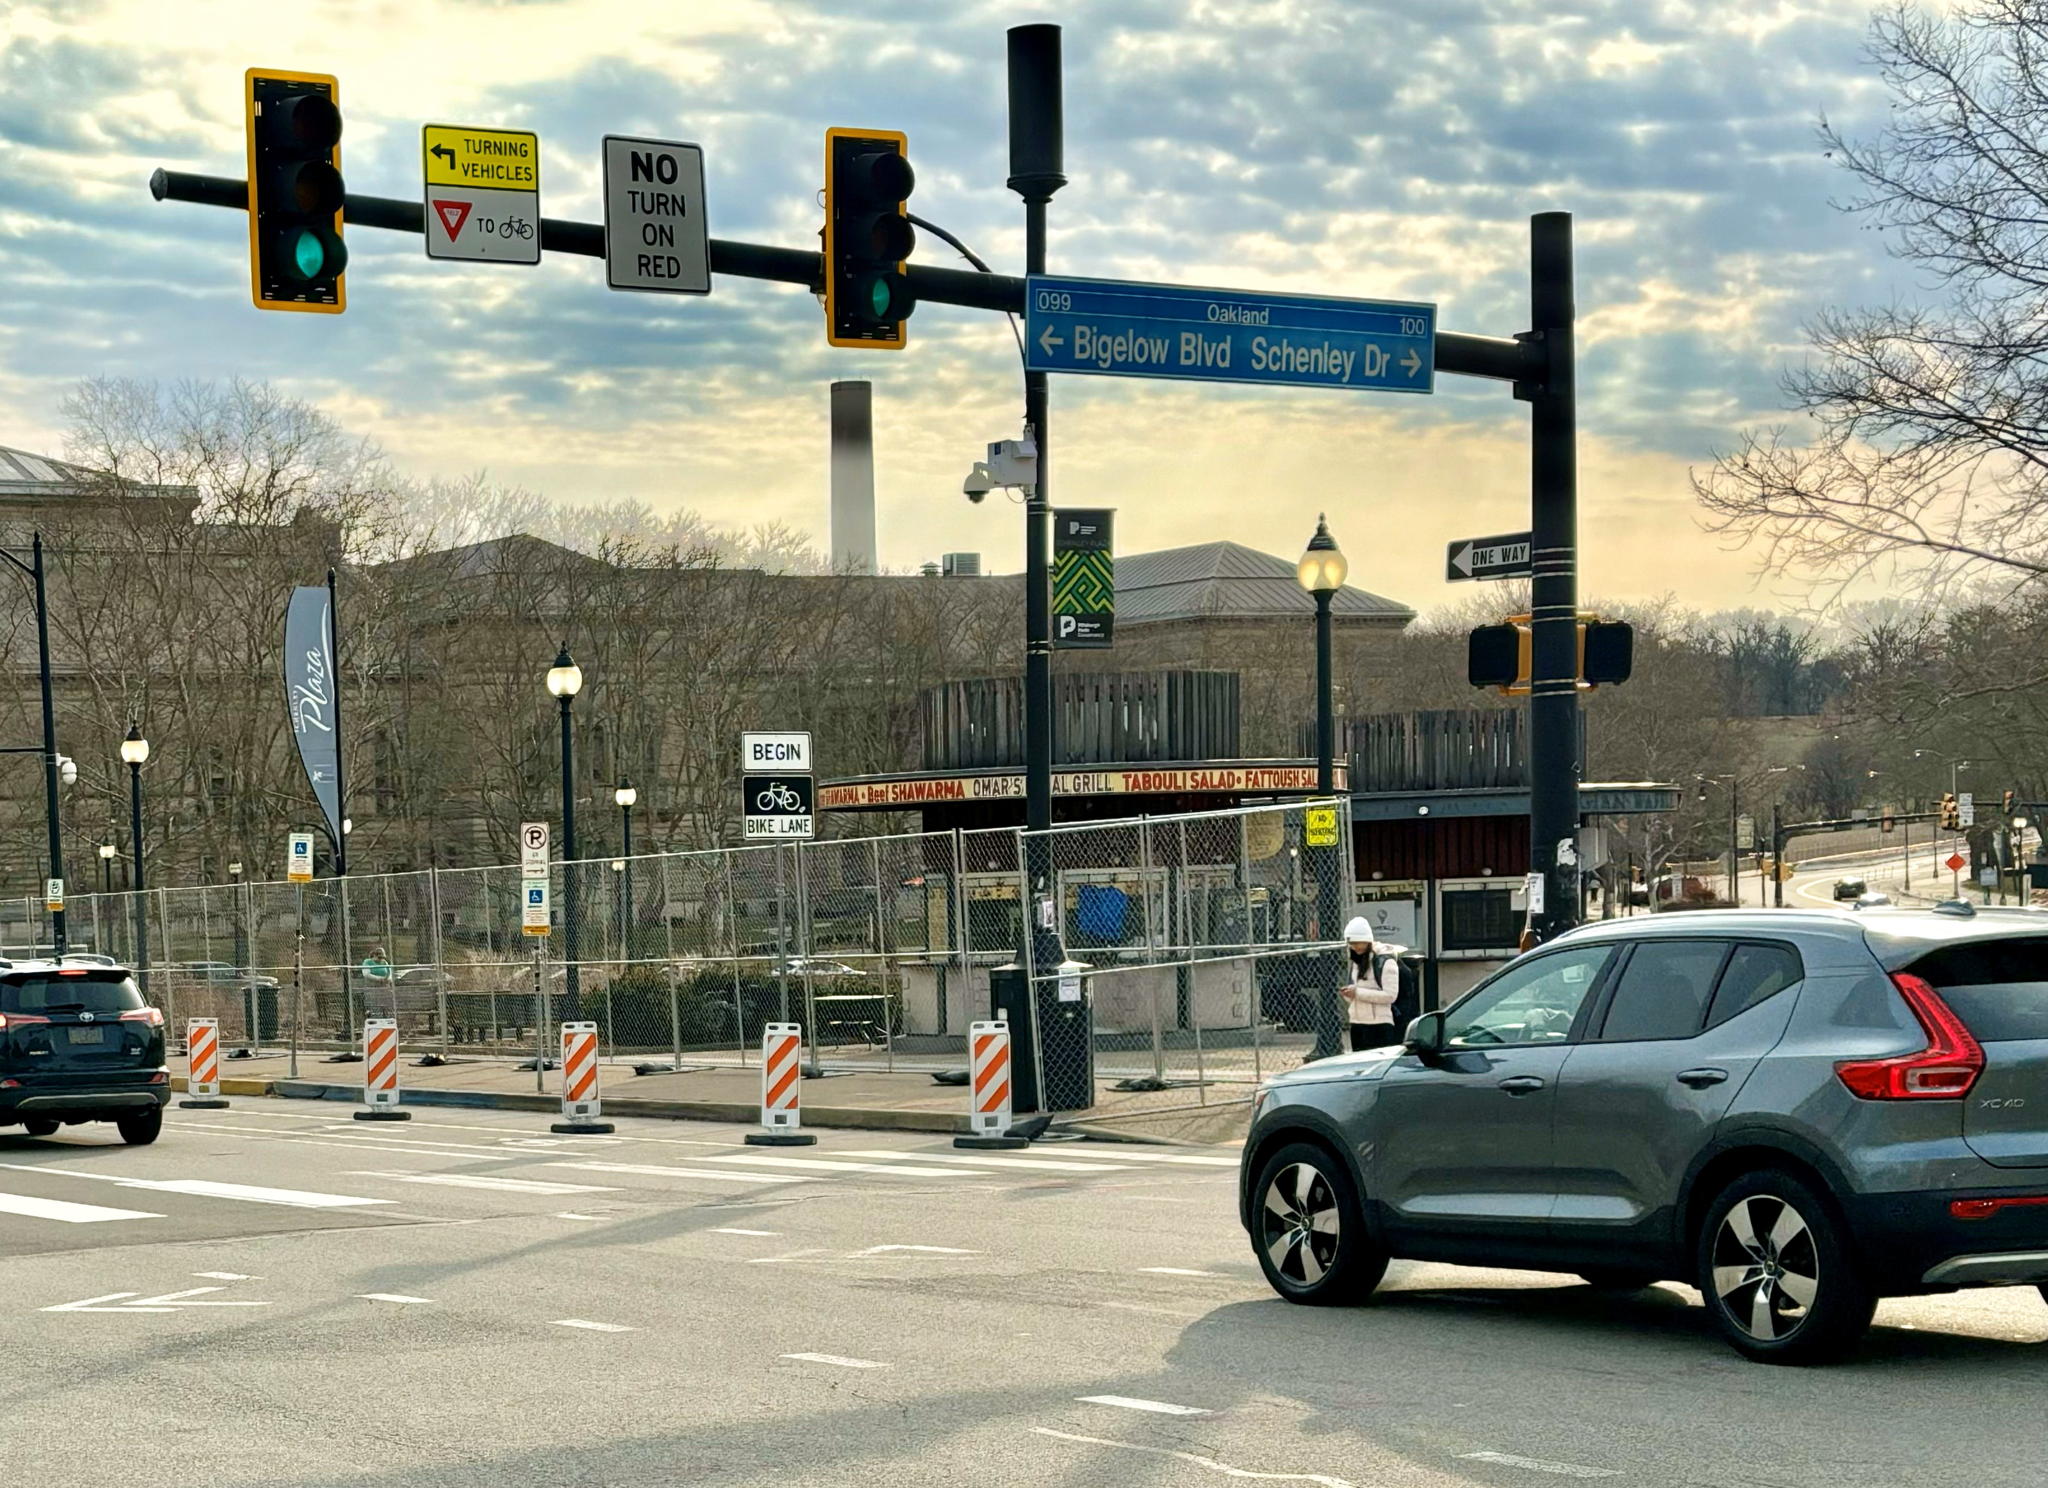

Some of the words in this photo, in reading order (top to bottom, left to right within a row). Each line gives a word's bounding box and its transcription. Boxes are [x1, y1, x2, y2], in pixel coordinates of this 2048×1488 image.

[463, 138, 528, 158] TURNING
[461, 163, 533, 182] VEHICLES
[631, 151, 678, 185] NO
[627, 190, 686, 218] TURN
[476, 217, 495, 233] TO
[642, 223, 674, 248] ON
[638, 254, 681, 279] RED
[1038, 292, 1072, 311] 099
[1207, 303, 1270, 325] Oakland
[1400, 318, 1425, 335] 100
[1074, 325, 1170, 369] Bigelow
[1179, 331, 1231, 368] Blvd
[1251, 335, 1355, 383] Schenley
[1364, 343, 1391, 378] Dr
[1472, 549, 1494, 566] ONE
[1501, 545, 1527, 563] WAY
[294, 647, 332, 733] Plaza
[753, 743, 801, 761] BEGIN
[973, 778, 1022, 797] OMAR'S
[1072, 773, 1112, 793] GRILL
[1122, 772, 1187, 791] TABOULI
[1190, 771, 1236, 789] SALAD
[1245, 769, 1300, 789] FATTOUSH
[867, 785, 889, 803] Beef
[891, 780, 965, 802] SHAWARMA
[747, 819, 775, 834] BIKE
[779, 819, 811, 834] LANE
